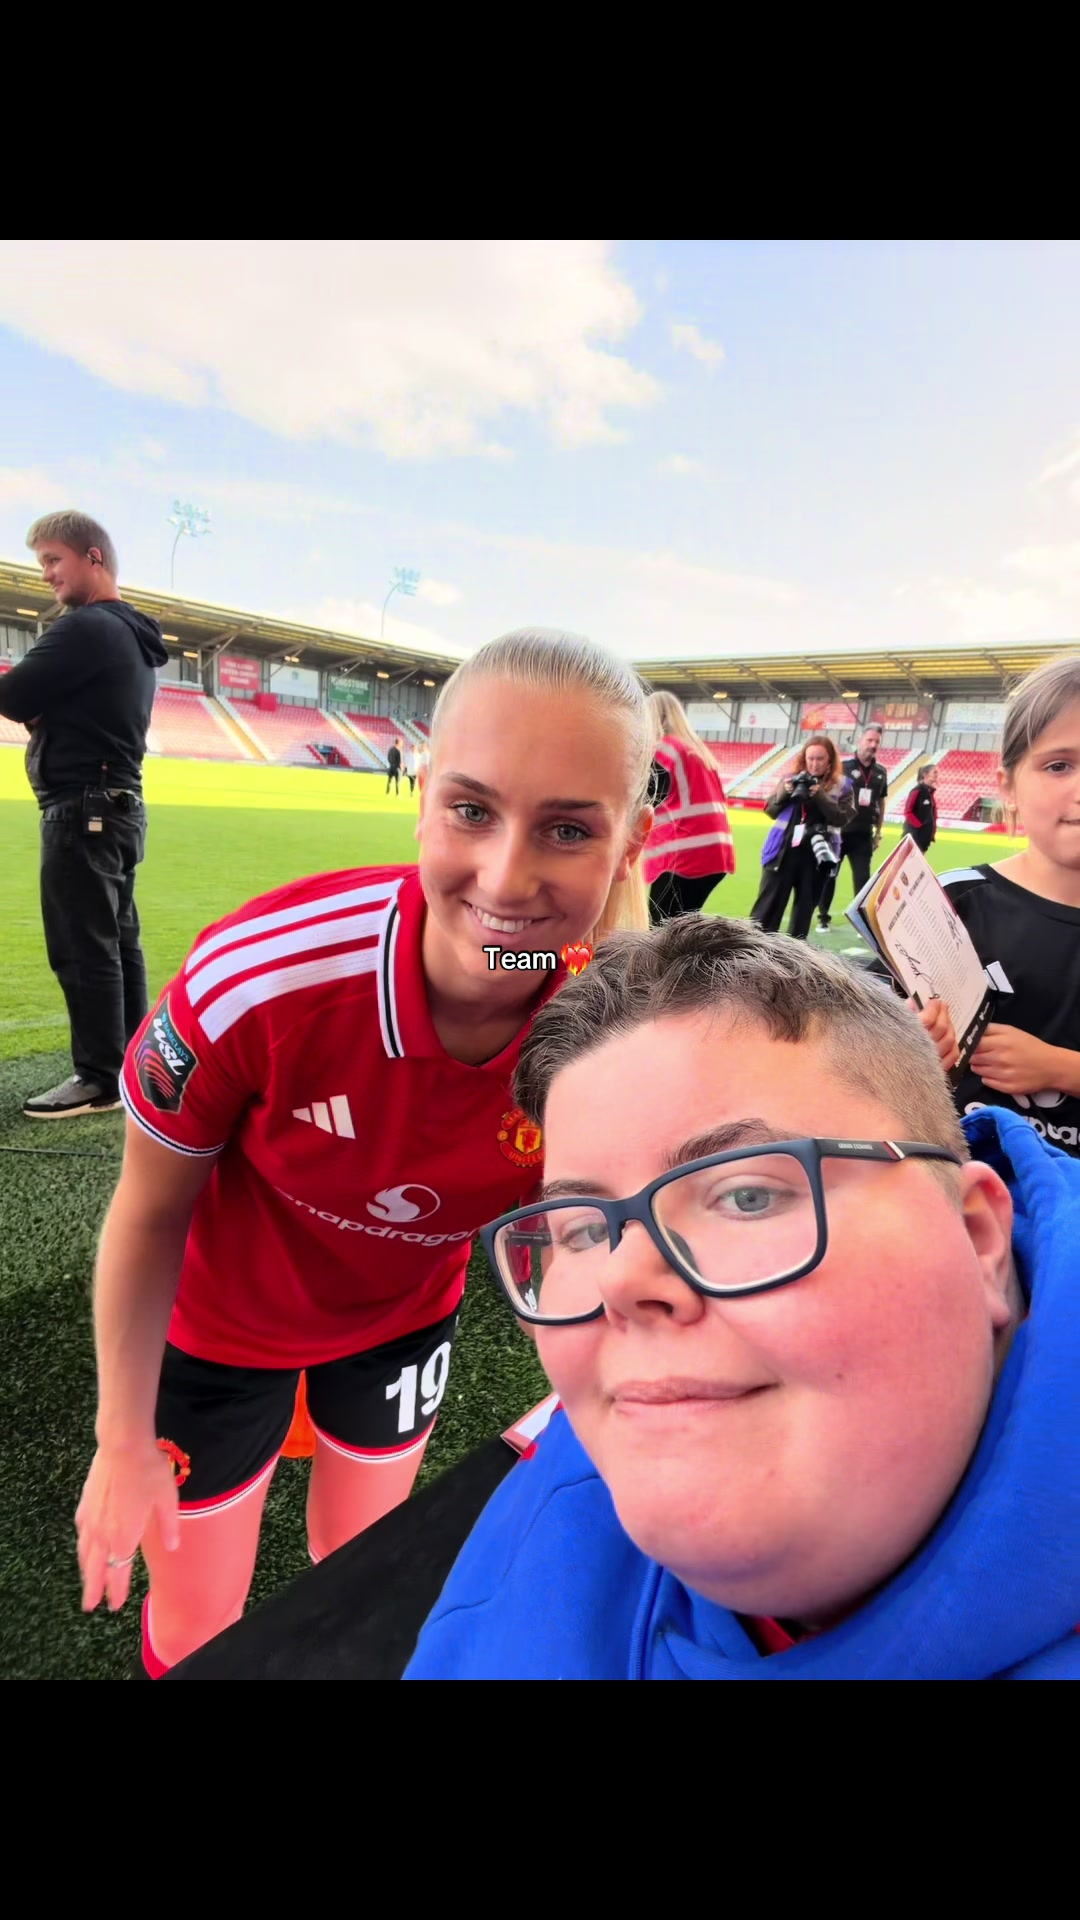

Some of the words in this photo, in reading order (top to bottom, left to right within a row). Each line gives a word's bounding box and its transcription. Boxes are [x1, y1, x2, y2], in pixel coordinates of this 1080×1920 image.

[163, 1022, 190, 1062] BARCLAYS
[274, 1186, 478, 1247] napdrago
[385, 1341, 452, 1433] 19
